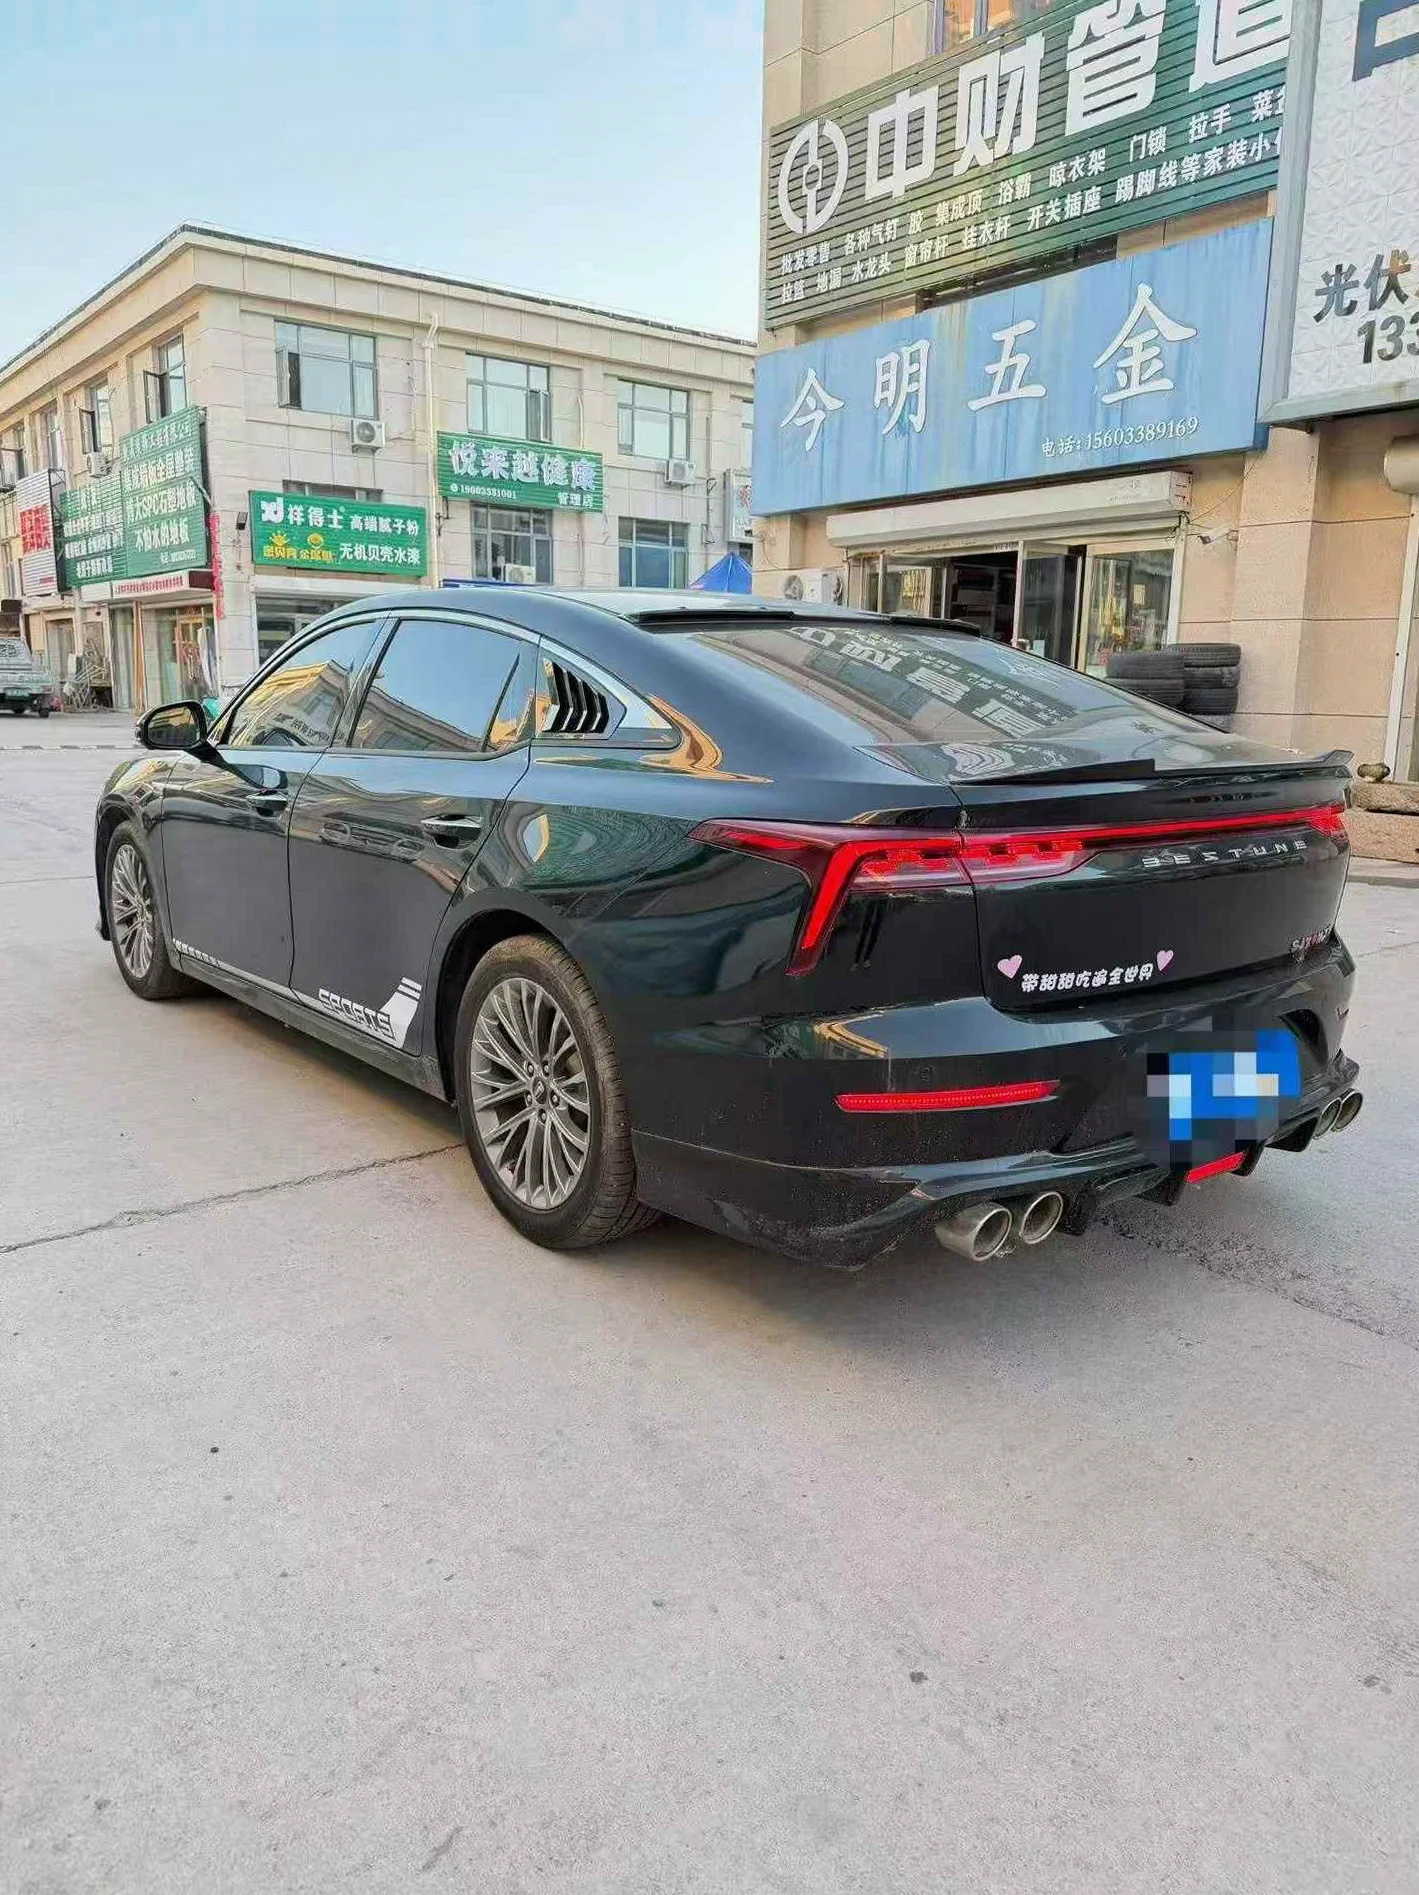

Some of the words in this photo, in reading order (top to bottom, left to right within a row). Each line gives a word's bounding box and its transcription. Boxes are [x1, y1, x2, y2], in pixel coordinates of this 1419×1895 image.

[781, 241, 831, 276] 批发零售
[935, 190, 983, 227] 集成顶
[999, 173, 1031, 205] 浴霸
[1049, 148, 1107, 189] 晾衣架
[1129, 126, 1167, 163] 门锁
[1188, 103, 1233, 143] 拉手
[816, 266, 842, 293] 地漏
[852, 251, 892, 281] 水龙头
[903, 235, 949, 270] 窗帘杆
[962, 215, 1011, 250] 挂衣杆
[1027, 186, 1102, 231] 开关插座
[1313, 249, 1419, 323] 光伏
[779, 282, 1197, 451] 今明五金
[339, 543, 421, 565] 无机贝壳水漆
[350, 515, 419, 536] 高端腻子粉
